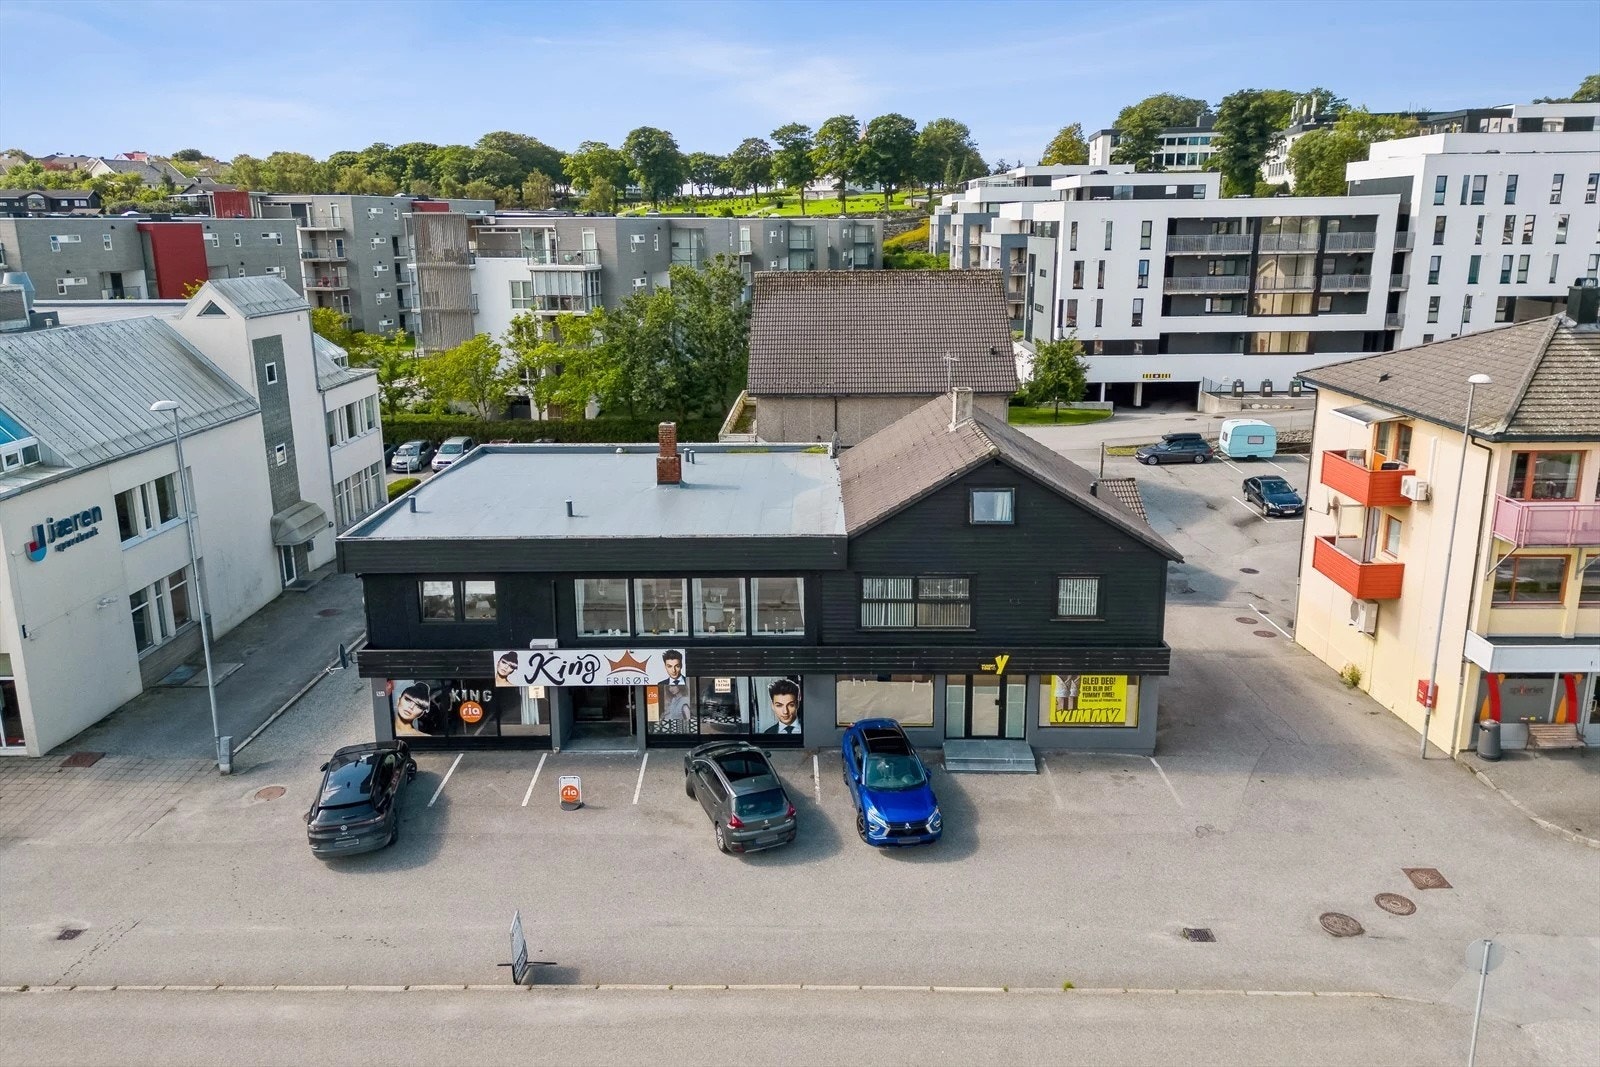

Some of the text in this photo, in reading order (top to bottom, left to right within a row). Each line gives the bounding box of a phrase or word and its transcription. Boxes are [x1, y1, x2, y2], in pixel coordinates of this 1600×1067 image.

[46, 505, 103, 544] jæren
[524, 652, 601, 686] King
[606, 676, 650, 685] FRISØR
[450, 688, 492, 702] KING
[463, 704, 481, 716] ria
[1055, 708, 1121, 723] YUMMY
[563, 787, 578, 796] ria
